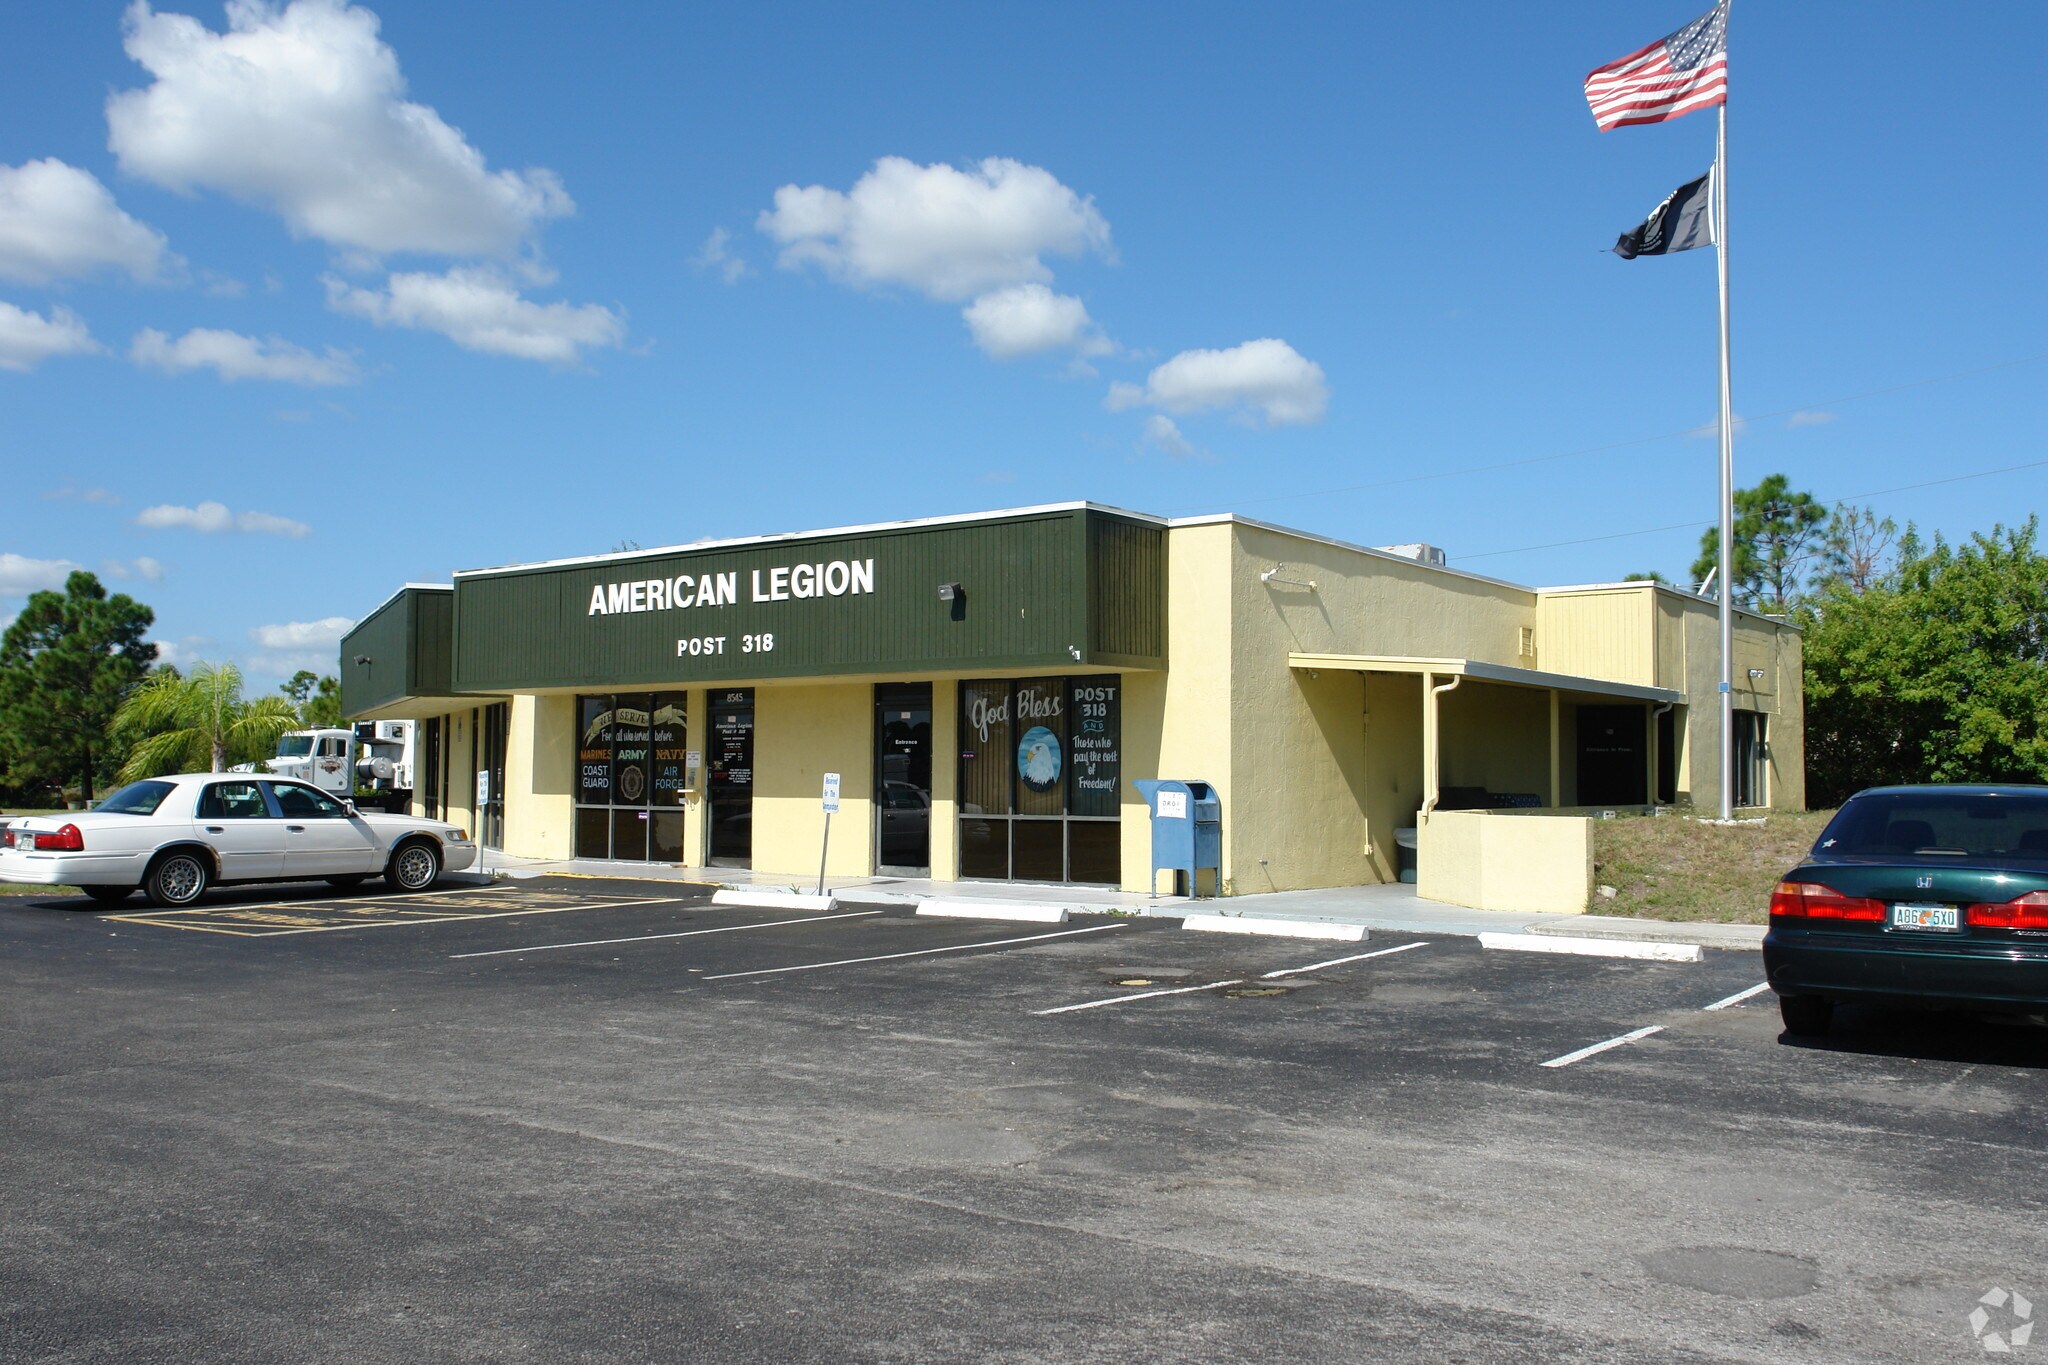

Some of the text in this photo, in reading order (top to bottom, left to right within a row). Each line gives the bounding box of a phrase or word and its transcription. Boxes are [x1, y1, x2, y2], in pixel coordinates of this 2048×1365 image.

[588, 558, 875, 616] AMERICAN LEGION
[677, 633, 774, 657] POST 318
[726, 692, 744, 703] 8545
[1074, 687, 1116, 702] POST
[972, 689, 1063, 743] God Bless
[1082, 703, 1107, 717] 318
[620, 711, 646, 724] SERVE
[1072, 735, 1112, 749] Those who
[580, 749, 612, 761] MARINES
[618, 750, 647, 760] ARMY
[656, 749, 686, 761] NAVY
[1074, 750, 1118, 766] pay the cost
[582, 765, 608, 776] COAST
[663, 766, 678, 776] AIR
[1088, 763, 1096, 775] of
[583, 777, 609, 788] GUARD
[655, 779, 684, 789] FORCE
[1078, 776, 1117, 793] Freedom!
[1896, 908, 1955, 926] A86 5XQ
